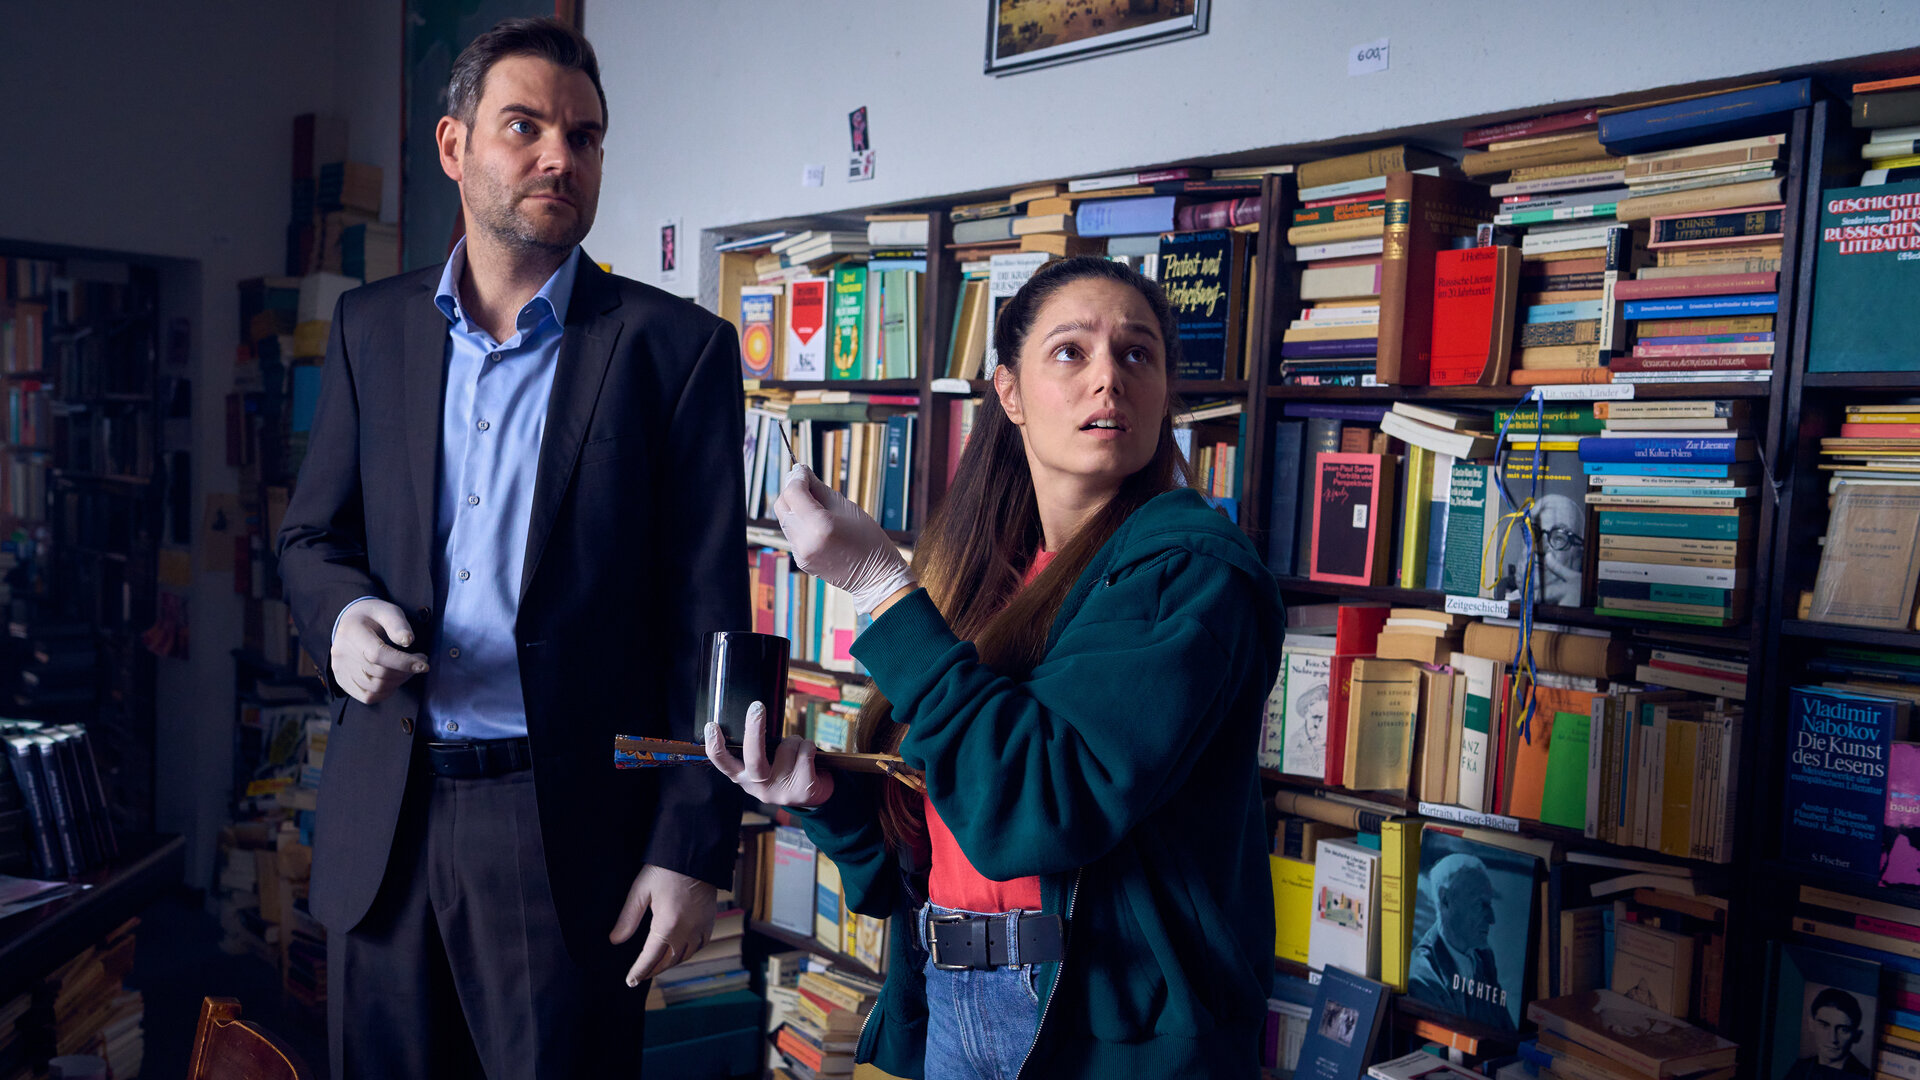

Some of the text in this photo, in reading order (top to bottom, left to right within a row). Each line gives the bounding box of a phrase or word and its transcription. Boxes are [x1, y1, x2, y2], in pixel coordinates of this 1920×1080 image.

[1676, 217, 1717, 230] CHINESE
[1675, 226, 1735, 241] LITERATURE
[1824, 222, 1920, 243] RUSSISCHEN
[1838, 235, 1920, 256] LITERATUR
[1162, 249, 1223, 280] Protest und
[1438, 277, 1469, 287] Russische
[1589, 388, 1619, 397] Länder
[1560, 411, 1580, 420] Guide
[1635, 449, 1648, 458] und
[1648, 449, 1670, 458] Kultur
[1670, 449, 1693, 458] Polens
[1685, 440, 1700, 450] Zur
[1700, 440, 1730, 450] Literatur
[1323, 464, 1374, 474] Jean-Paul Sartre
[1333, 478, 1373, 488] Perspektiven
[1592, 476, 1604, 485] dtv
[1446, 597, 1508, 615] Zeitgeschichte
[1802, 697, 1882, 725] Vladimir
[1801, 714, 1881, 742] Nabokov
[1462, 739, 1480, 756] ANZ
[1797, 731, 1884, 760] Die Kunst
[1462, 756, 1478, 774] FKA
[1791, 748, 1885, 778] des Lesens
[1791, 773, 1884, 795] europäischen Literatur
[1856, 775, 1872, 786] der
[1801, 801, 1869, 822] Austen Dickens
[1890, 801, 1920, 814] baud
[1420, 803, 1518, 831] Portraits, Leser-Bücher
[1833, 816, 1876, 832] Stevenson
[1822, 822, 1847, 835] Kafka
[1850, 828, 1877, 841] Joyce
[1452, 973, 1508, 1008] DICHTER
